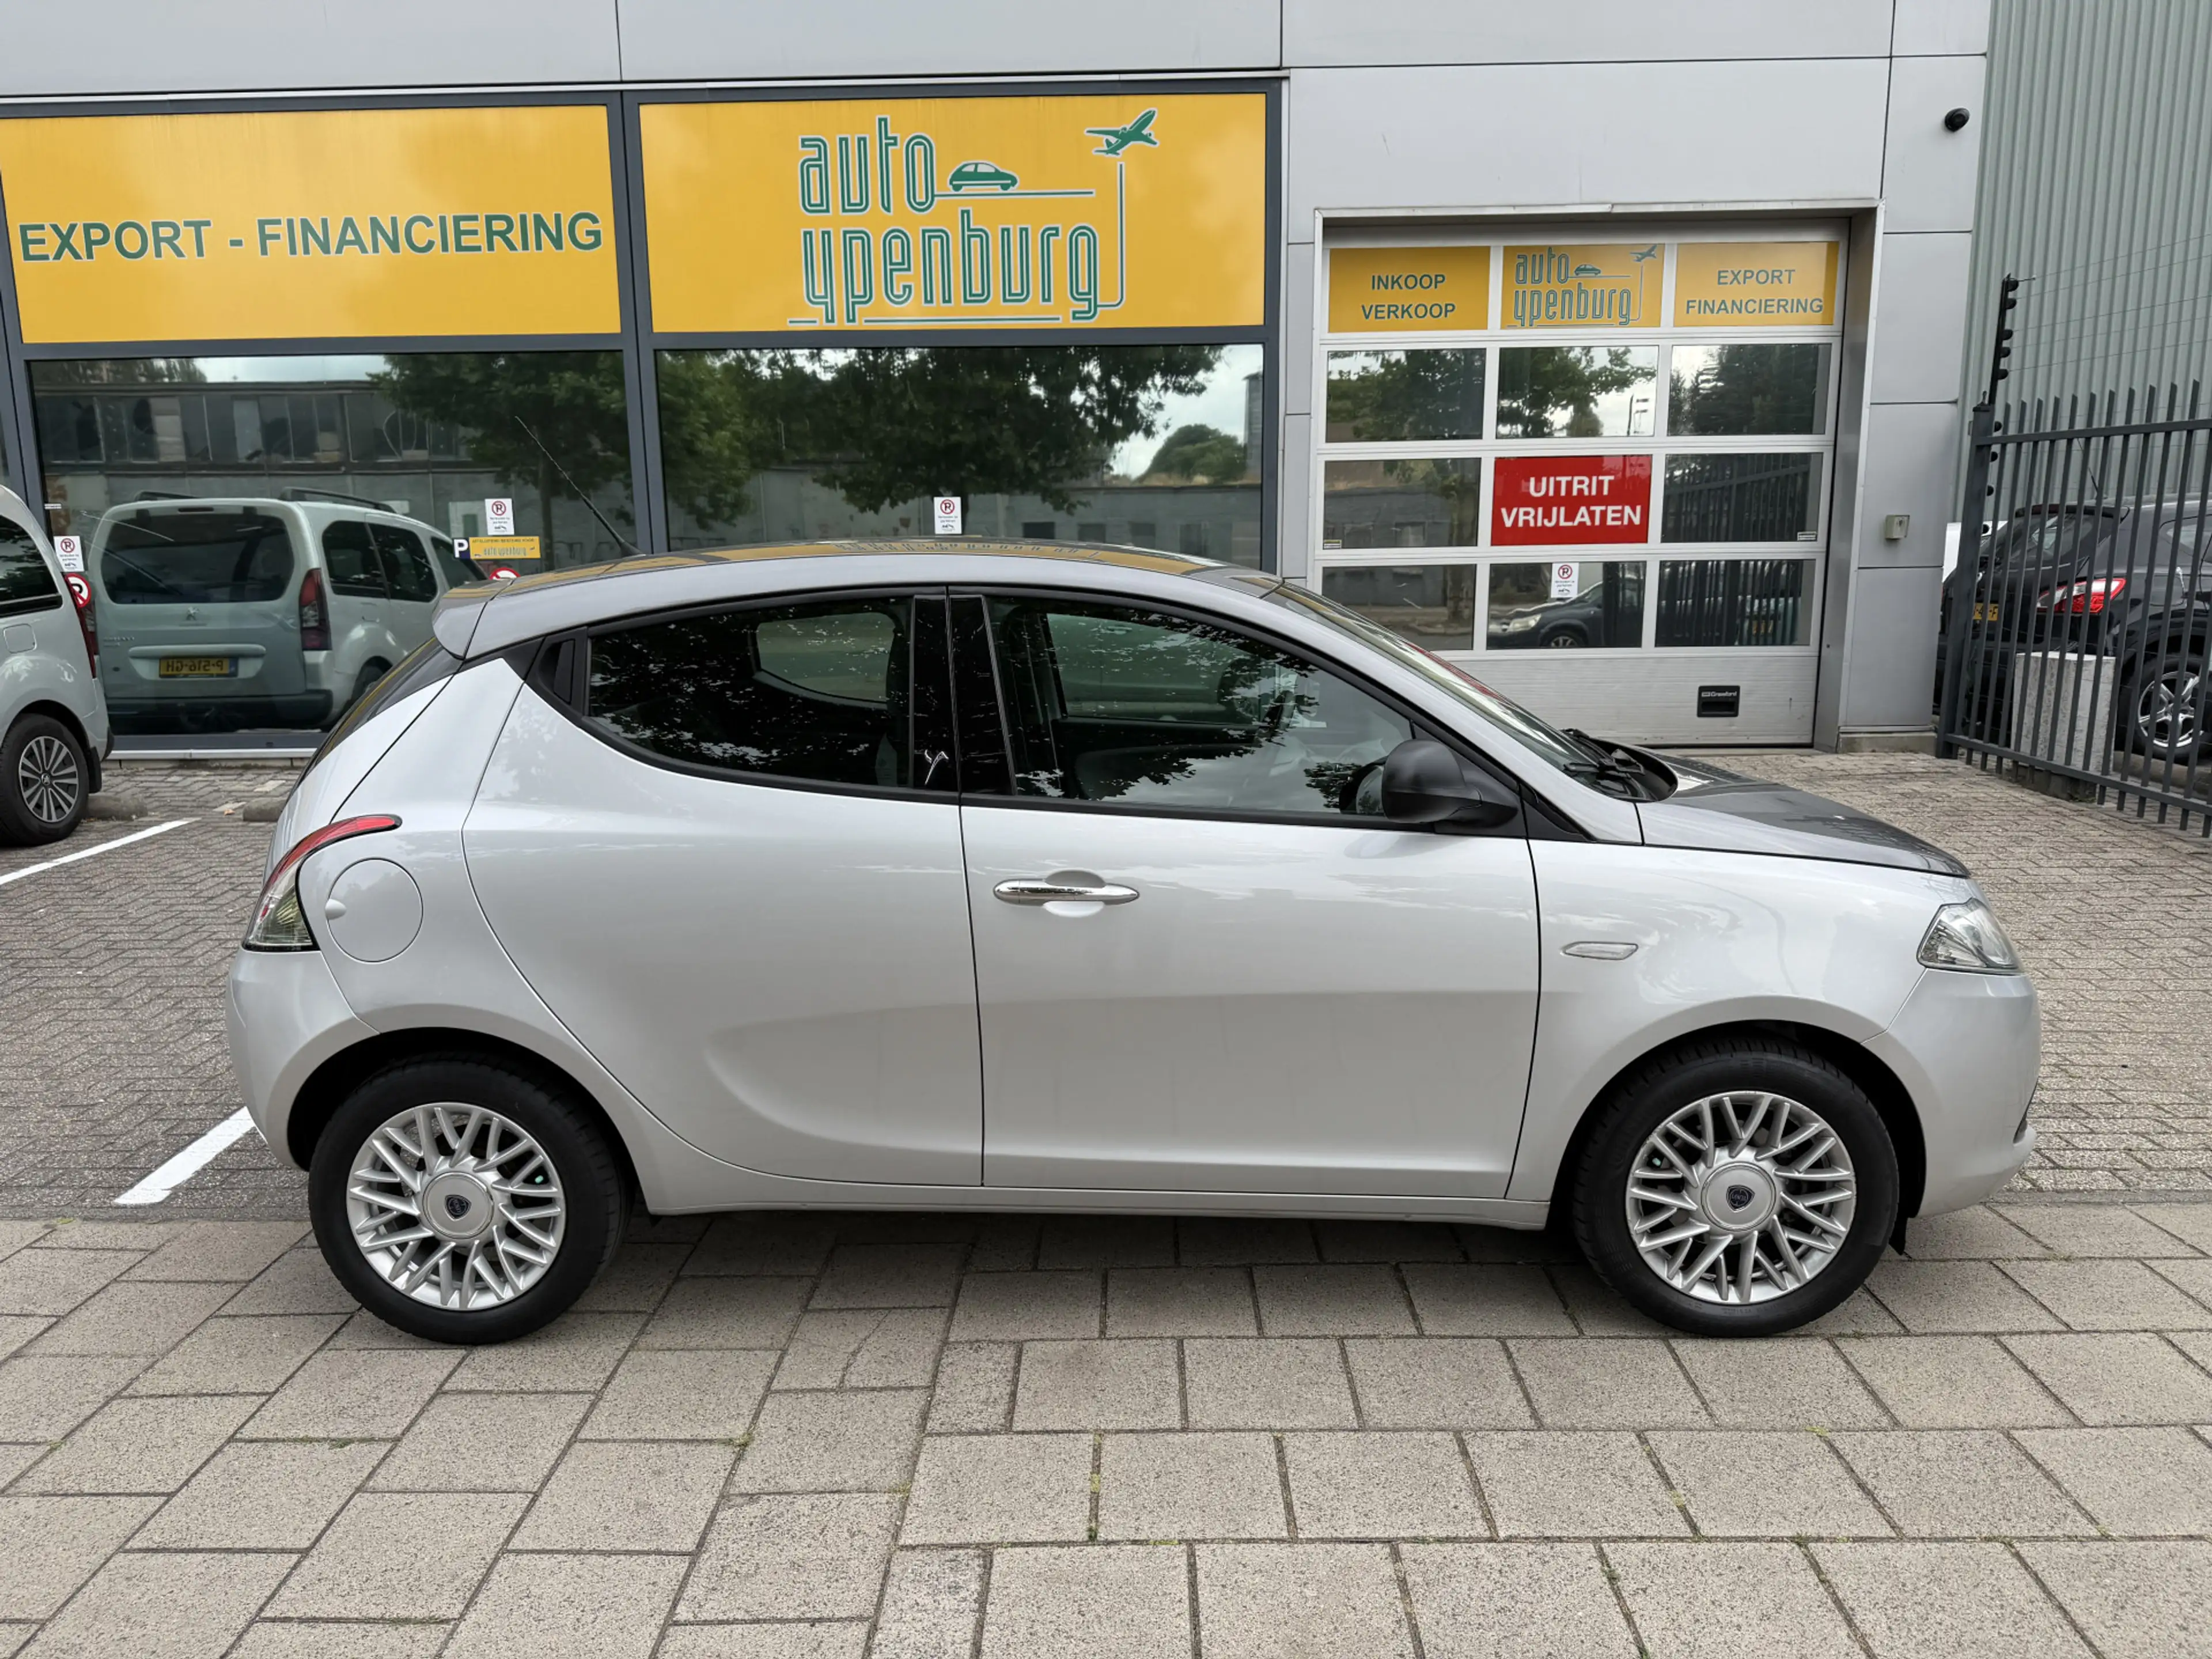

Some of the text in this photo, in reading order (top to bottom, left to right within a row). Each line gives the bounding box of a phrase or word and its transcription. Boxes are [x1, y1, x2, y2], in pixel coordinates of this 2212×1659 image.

[798, 115, 935, 215] auto
[18, 219, 212, 263] EXPORT
[256, 211, 603, 257] FINANCIERING
[801, 207, 1099, 325] ypenburg
[1514, 246, 1570, 285] auto
[1372, 274, 1446, 290] INKOOP
[1717, 270, 1796, 285] EXPORT
[1361, 303, 1456, 320] VERKOOP
[1513, 282, 1631, 327] ypenburg
[1685, 298, 1824, 315] FINANCIERING
[1529, 475, 1615, 498] UITRIT
[1501, 505, 1641, 528] VRIJLATEN
[453, 539, 469, 558] P
